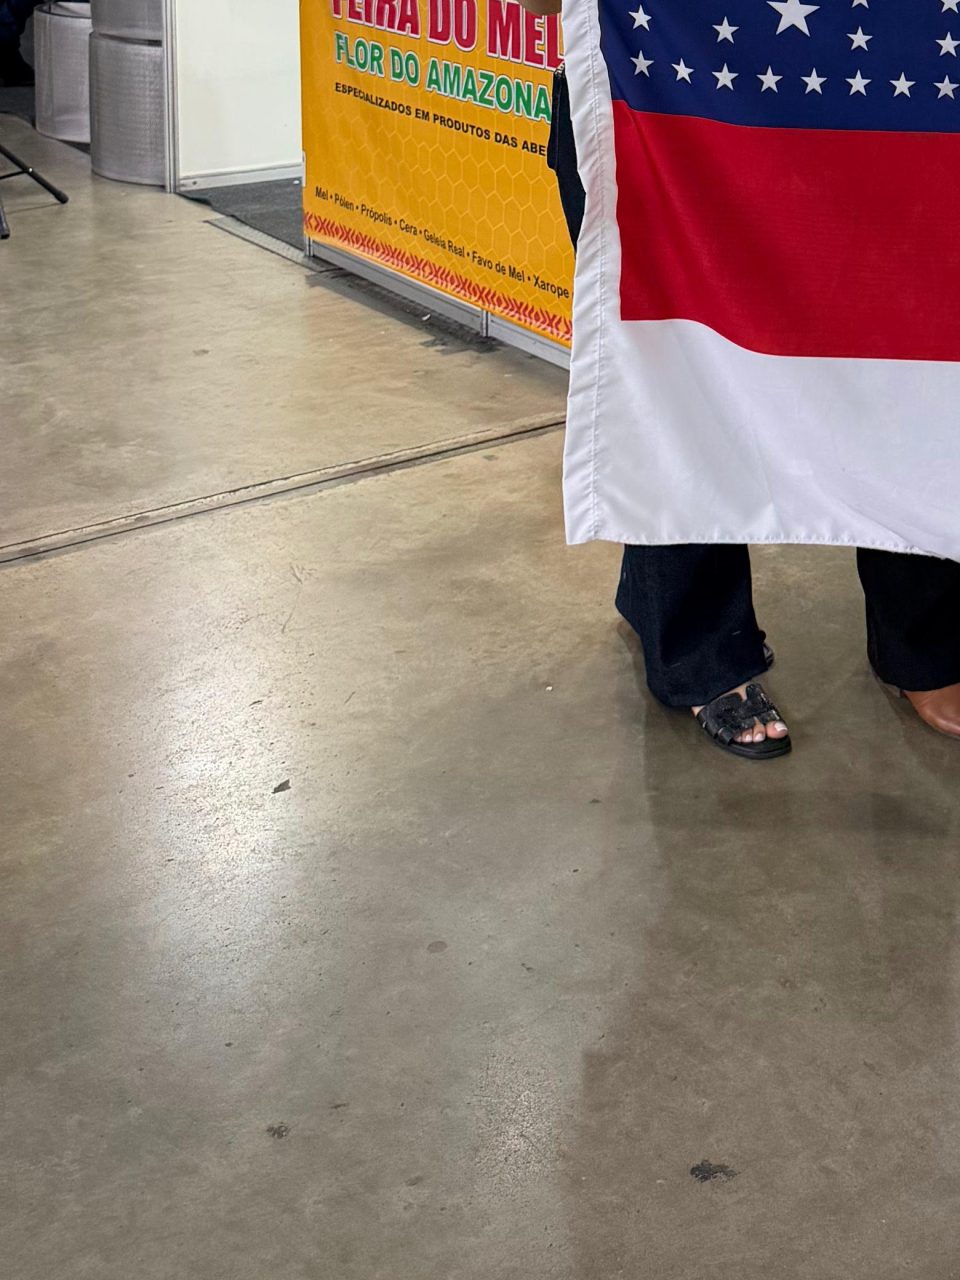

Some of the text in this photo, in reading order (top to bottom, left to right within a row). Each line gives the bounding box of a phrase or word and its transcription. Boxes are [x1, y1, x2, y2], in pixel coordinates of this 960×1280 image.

[335, 31, 552, 124] FLOR DO AMAZONA
[335, 82, 412, 117] ESPECIALIZADOS
[415, 108, 430, 121] EM
[432, 114, 490, 141] PRODUTOS
[494, 132, 518, 148] DAS
[315, 186, 328, 200] Mel
[334, 193, 354, 211] Pólen
[361, 203, 393, 226] Própolis
[399, 219, 418, 236] Cera
[447, 240, 465, 257] Real
[472, 251, 493, 270] Favo
[495, 263, 506, 275] de
[508, 265, 525, 282] Mel
[533, 274, 570, 299] Xarope
